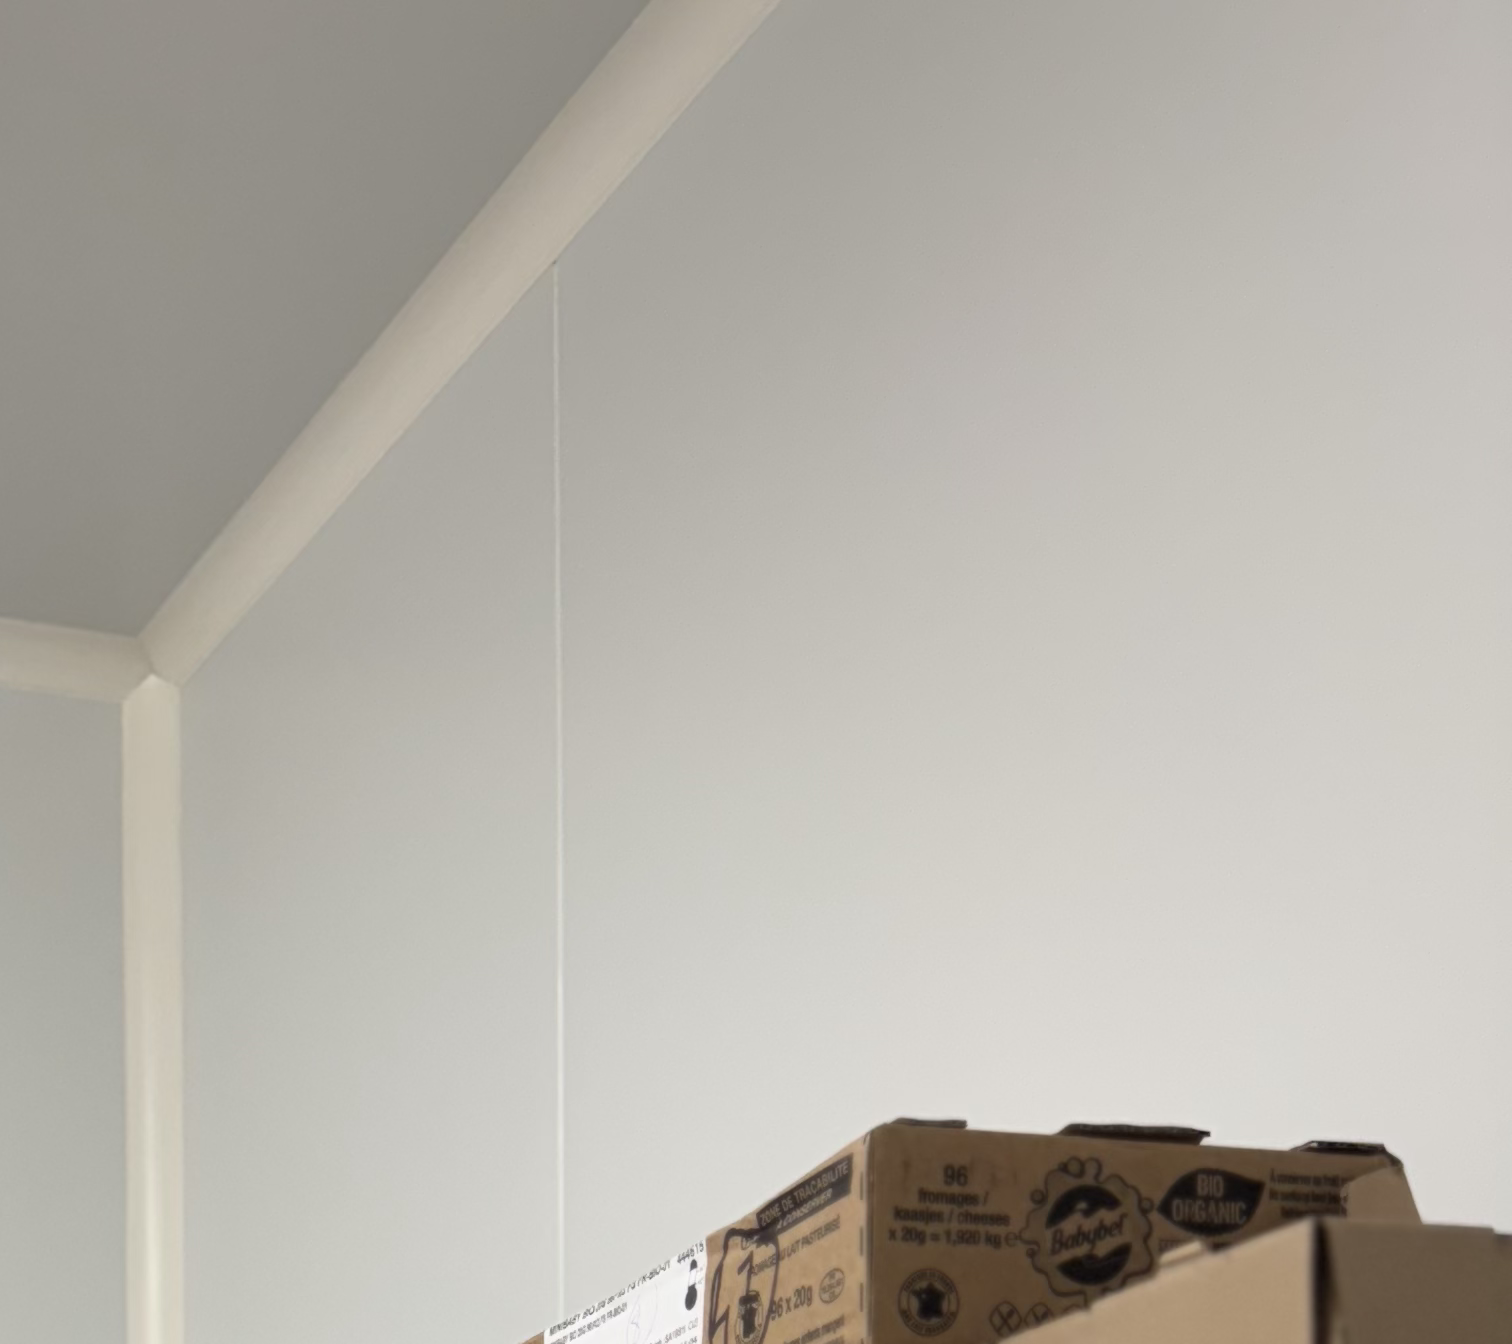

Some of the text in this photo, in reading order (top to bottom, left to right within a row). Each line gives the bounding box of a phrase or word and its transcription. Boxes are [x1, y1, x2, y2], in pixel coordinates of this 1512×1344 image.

[944, 1164, 968, 1187] 96
[1197, 1173, 1225, 1197] BIO
[1172, 1199, 1247, 1225] ORGANIC
[1050, 1213, 1128, 1256] Babybel
